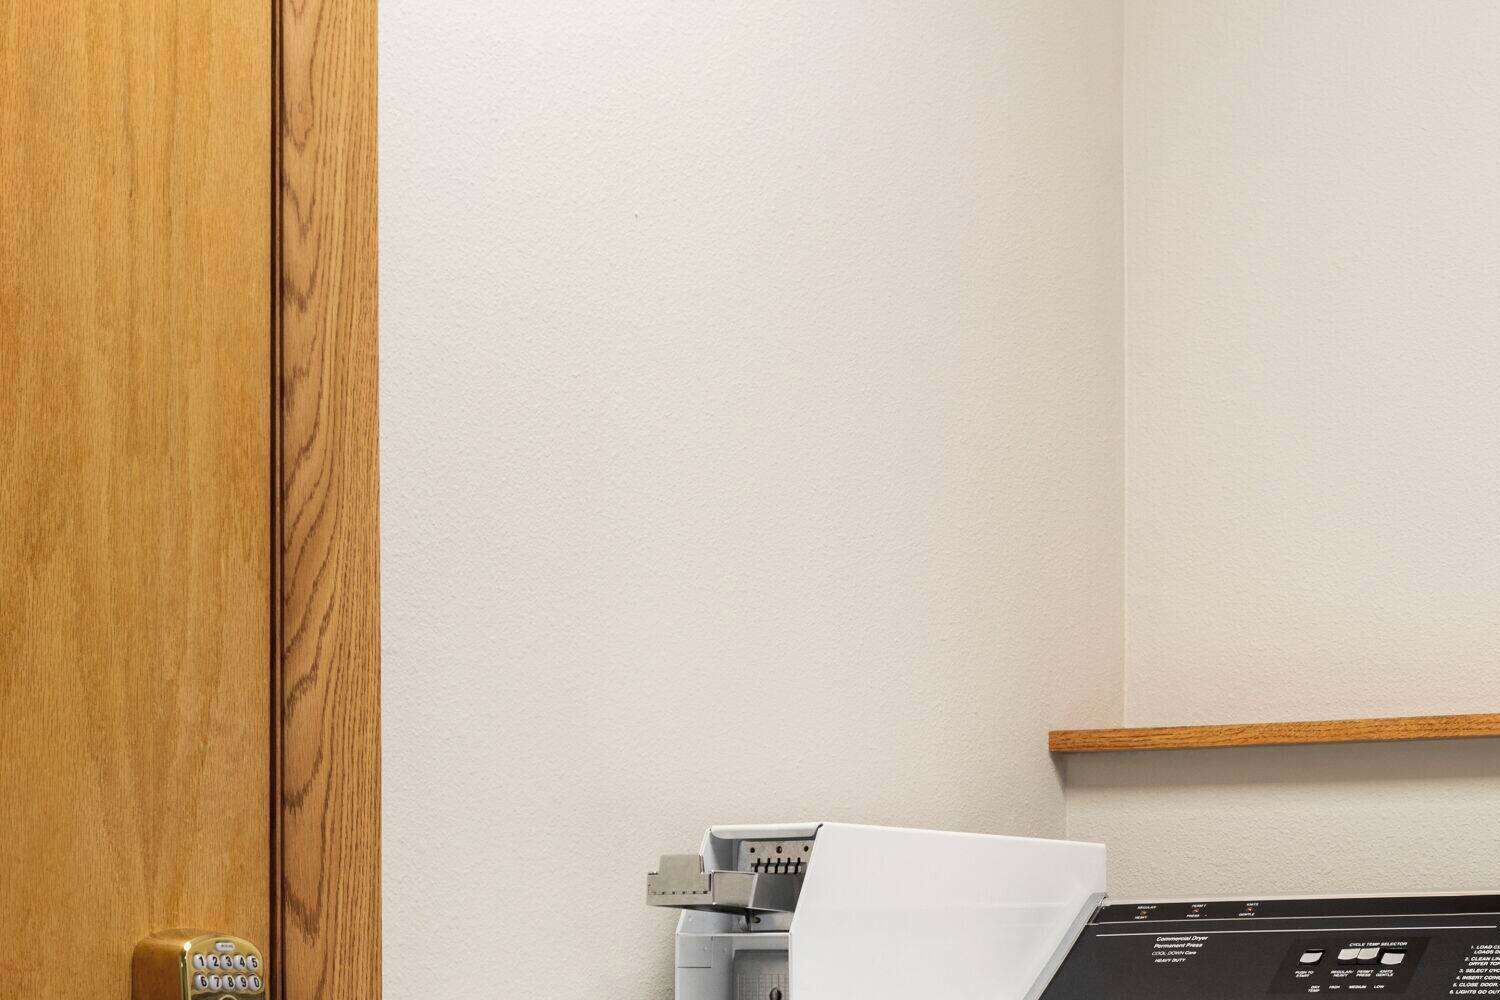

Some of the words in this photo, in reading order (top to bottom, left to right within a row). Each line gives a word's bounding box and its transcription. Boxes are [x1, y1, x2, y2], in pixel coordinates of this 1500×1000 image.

[199, 956, 204, 966] 1
[213, 957, 219, 966] 2
[226, 956, 232, 966] 3
[240, 957, 245, 967] 4
[252, 958, 257, 967] 5
[201, 976, 207, 986] 6
[214, 977, 220, 987] 7
[228, 977, 234, 987] 8
[241, 977, 246, 987] 9
[254, 977, 259, 987] 0
